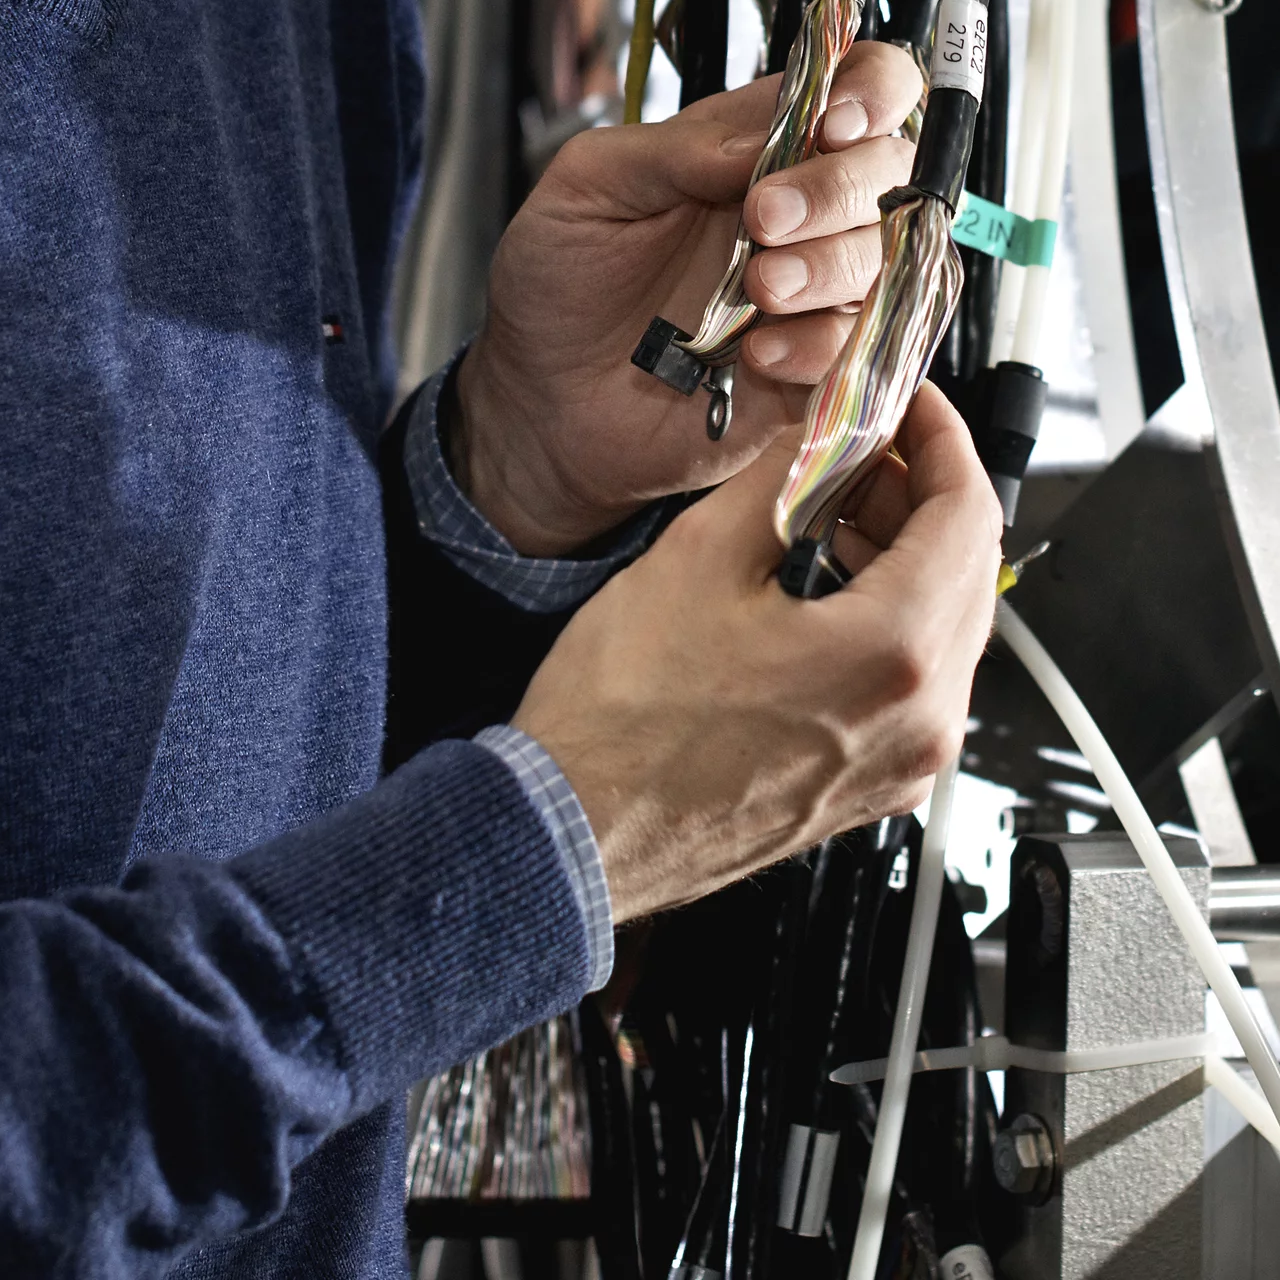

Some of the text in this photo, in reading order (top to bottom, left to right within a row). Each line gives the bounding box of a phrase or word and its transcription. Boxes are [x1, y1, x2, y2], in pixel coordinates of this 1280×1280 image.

[943, 22, 967, 63] 279
[970, 19, 986, 75] ePC2
[987, 218, 1017, 249] IN
